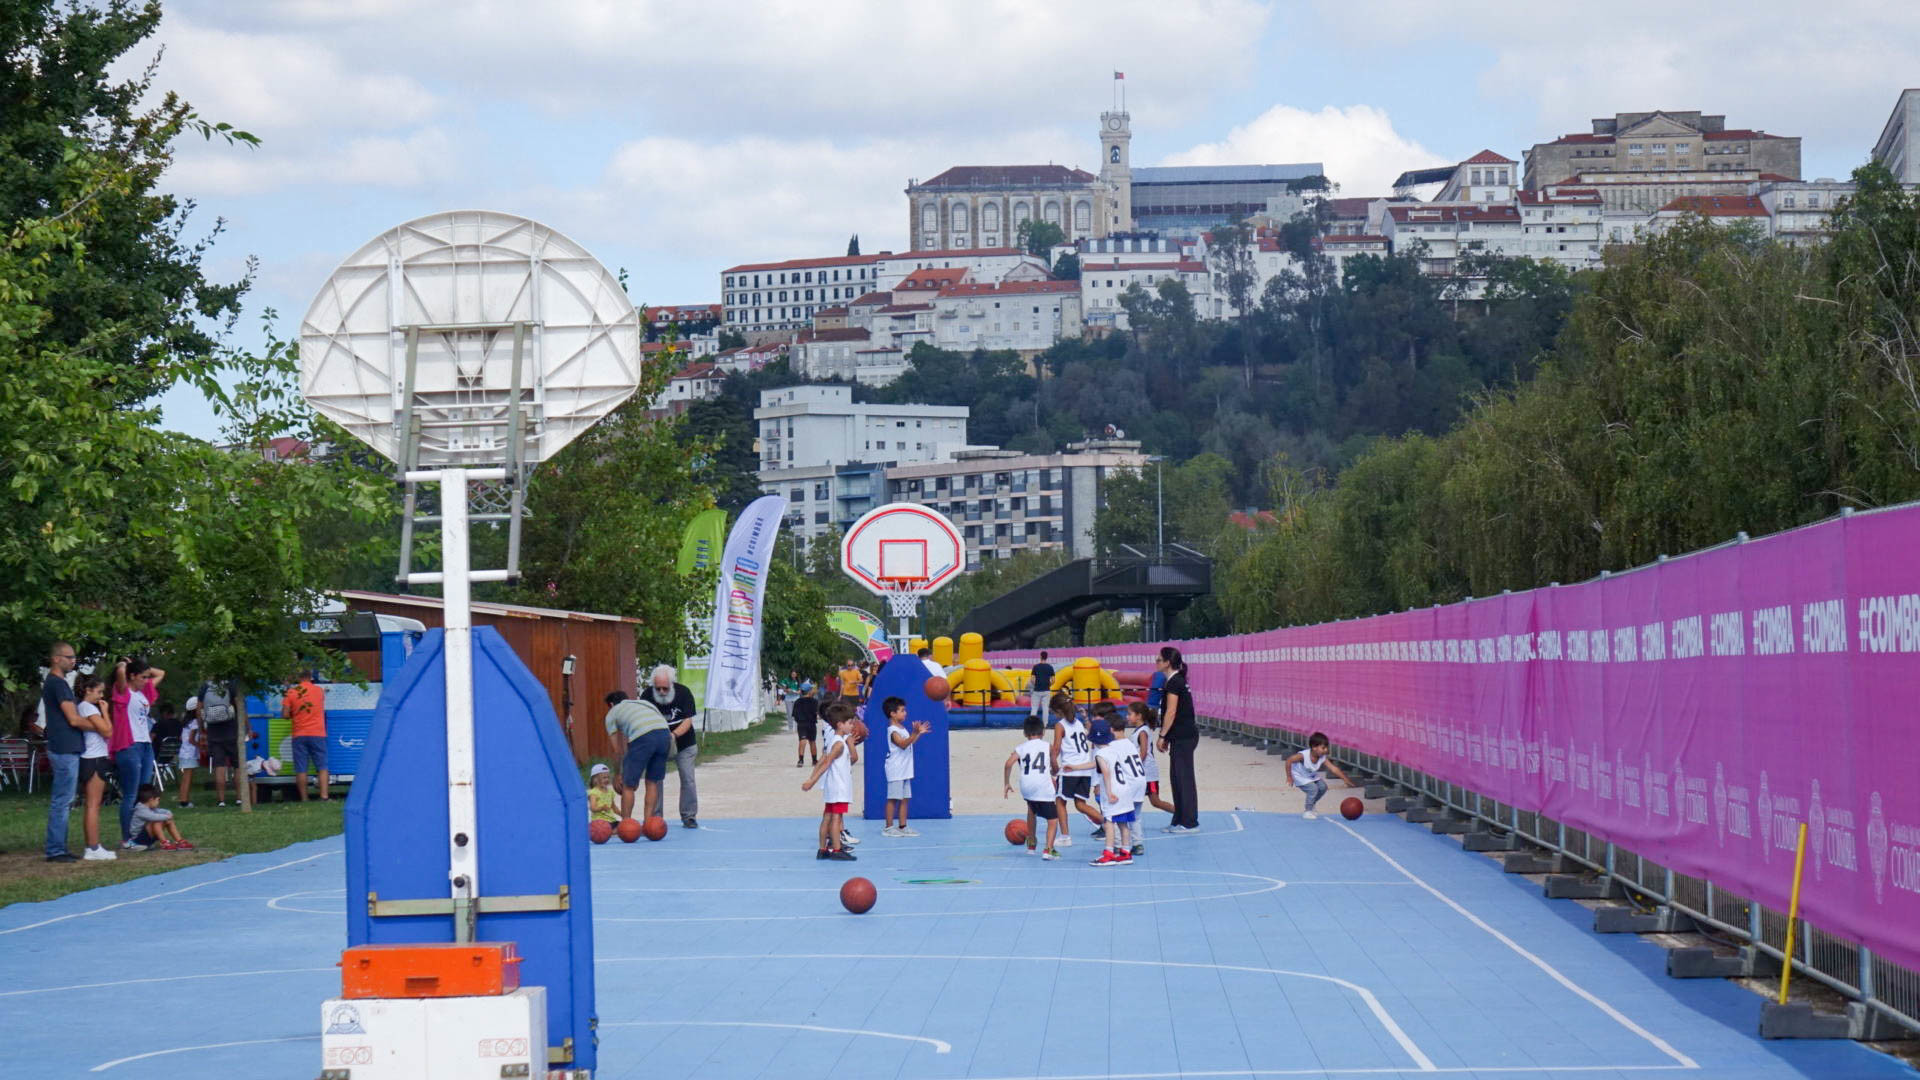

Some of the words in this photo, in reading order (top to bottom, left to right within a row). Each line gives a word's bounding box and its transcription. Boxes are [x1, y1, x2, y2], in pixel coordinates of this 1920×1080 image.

[728, 556, 760, 625] DESPORTO
[1803, 599, 1848, 653] #COIMBRA
[721, 627, 752, 671] EXPO
[1071, 731, 1089, 754] 18
[1022, 751, 1046, 775] 14
[1124, 754, 1145, 778] 15
